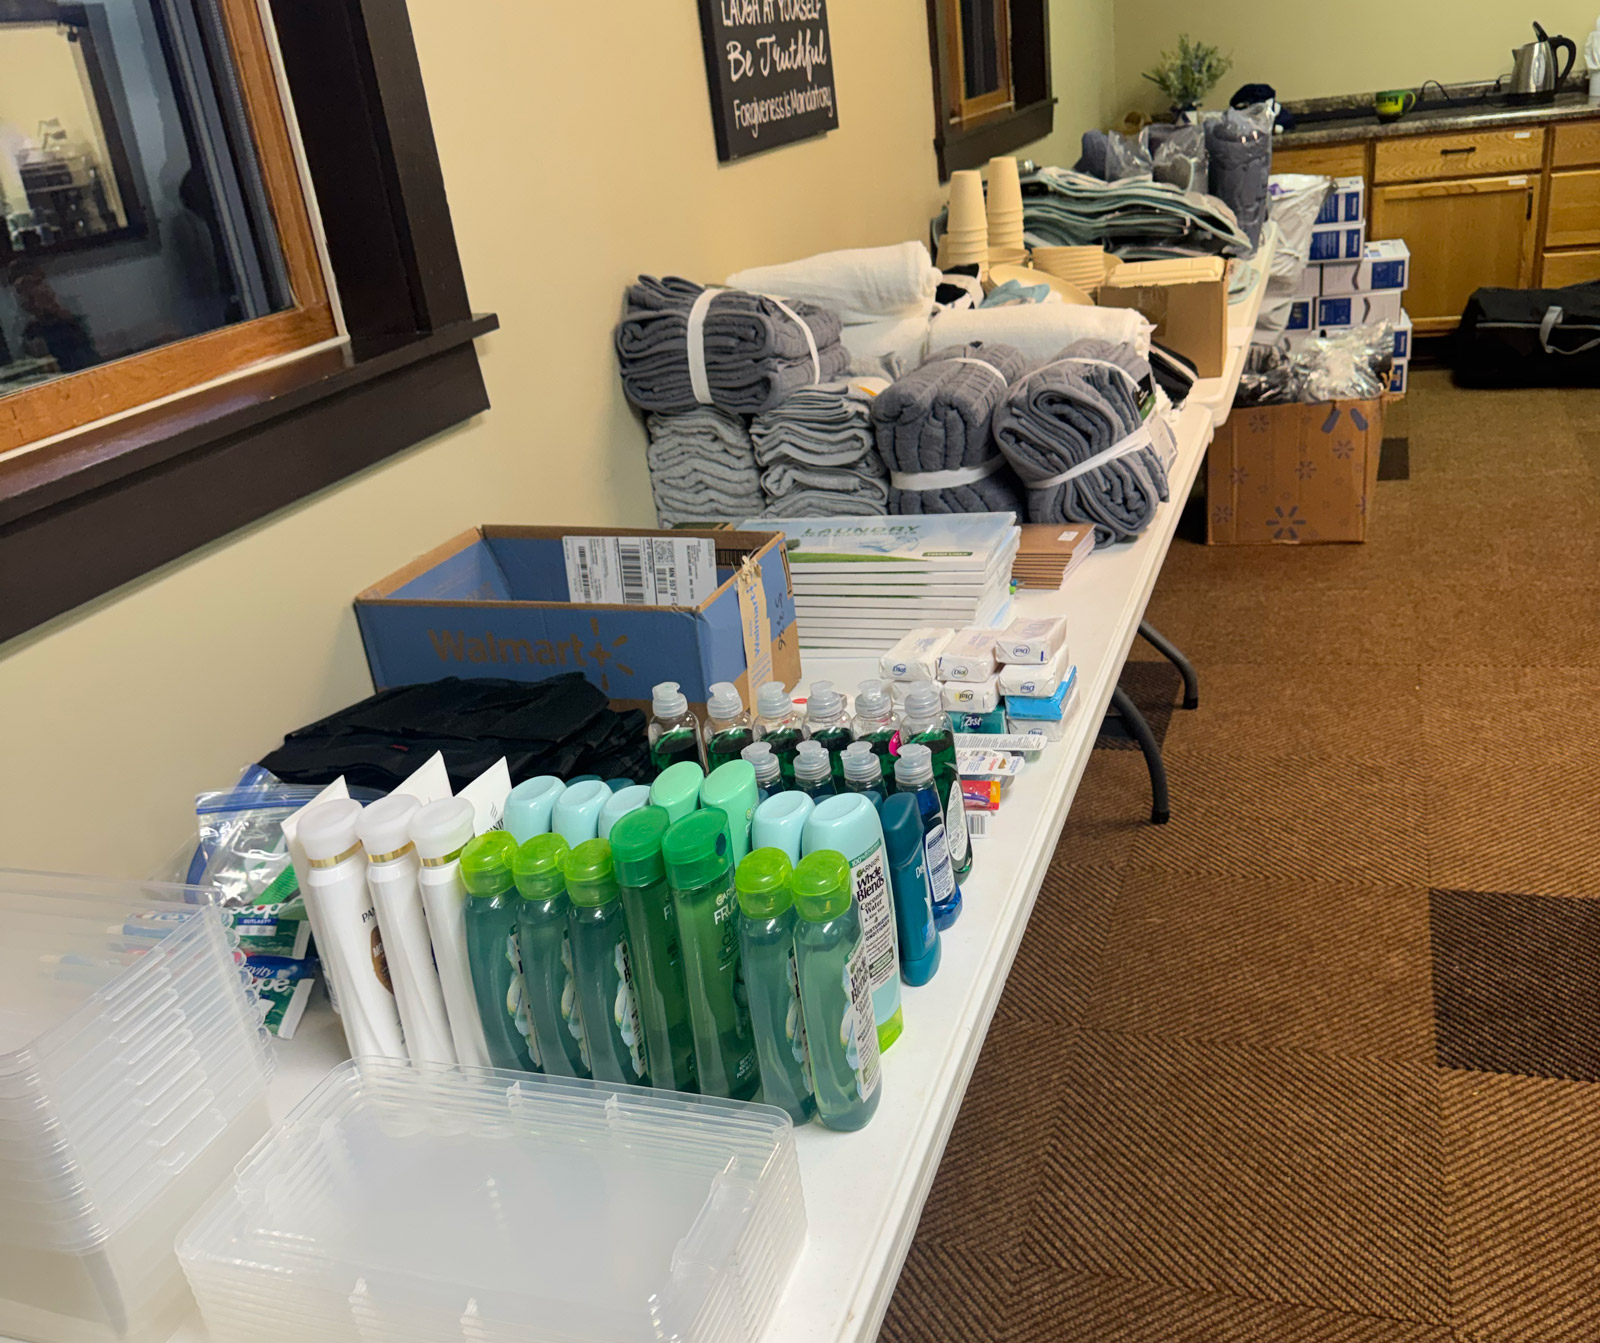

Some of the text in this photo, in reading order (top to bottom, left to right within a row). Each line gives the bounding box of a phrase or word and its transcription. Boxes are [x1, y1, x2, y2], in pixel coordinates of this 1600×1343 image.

[763, 0, 775, 23] AT
[726, 28, 827, 82] Be Truthful
[803, 525, 921, 534] LAUNDRY
[750, 594, 760, 658] Walmart
[429, 629, 587, 667] Walmart
[964, 715, 984, 728] Zest
[856, 866, 882, 890] Whole
[856, 876, 884, 903] Blends
[860, 888, 884, 911] Coconut
[865, 898, 882, 915] Water
